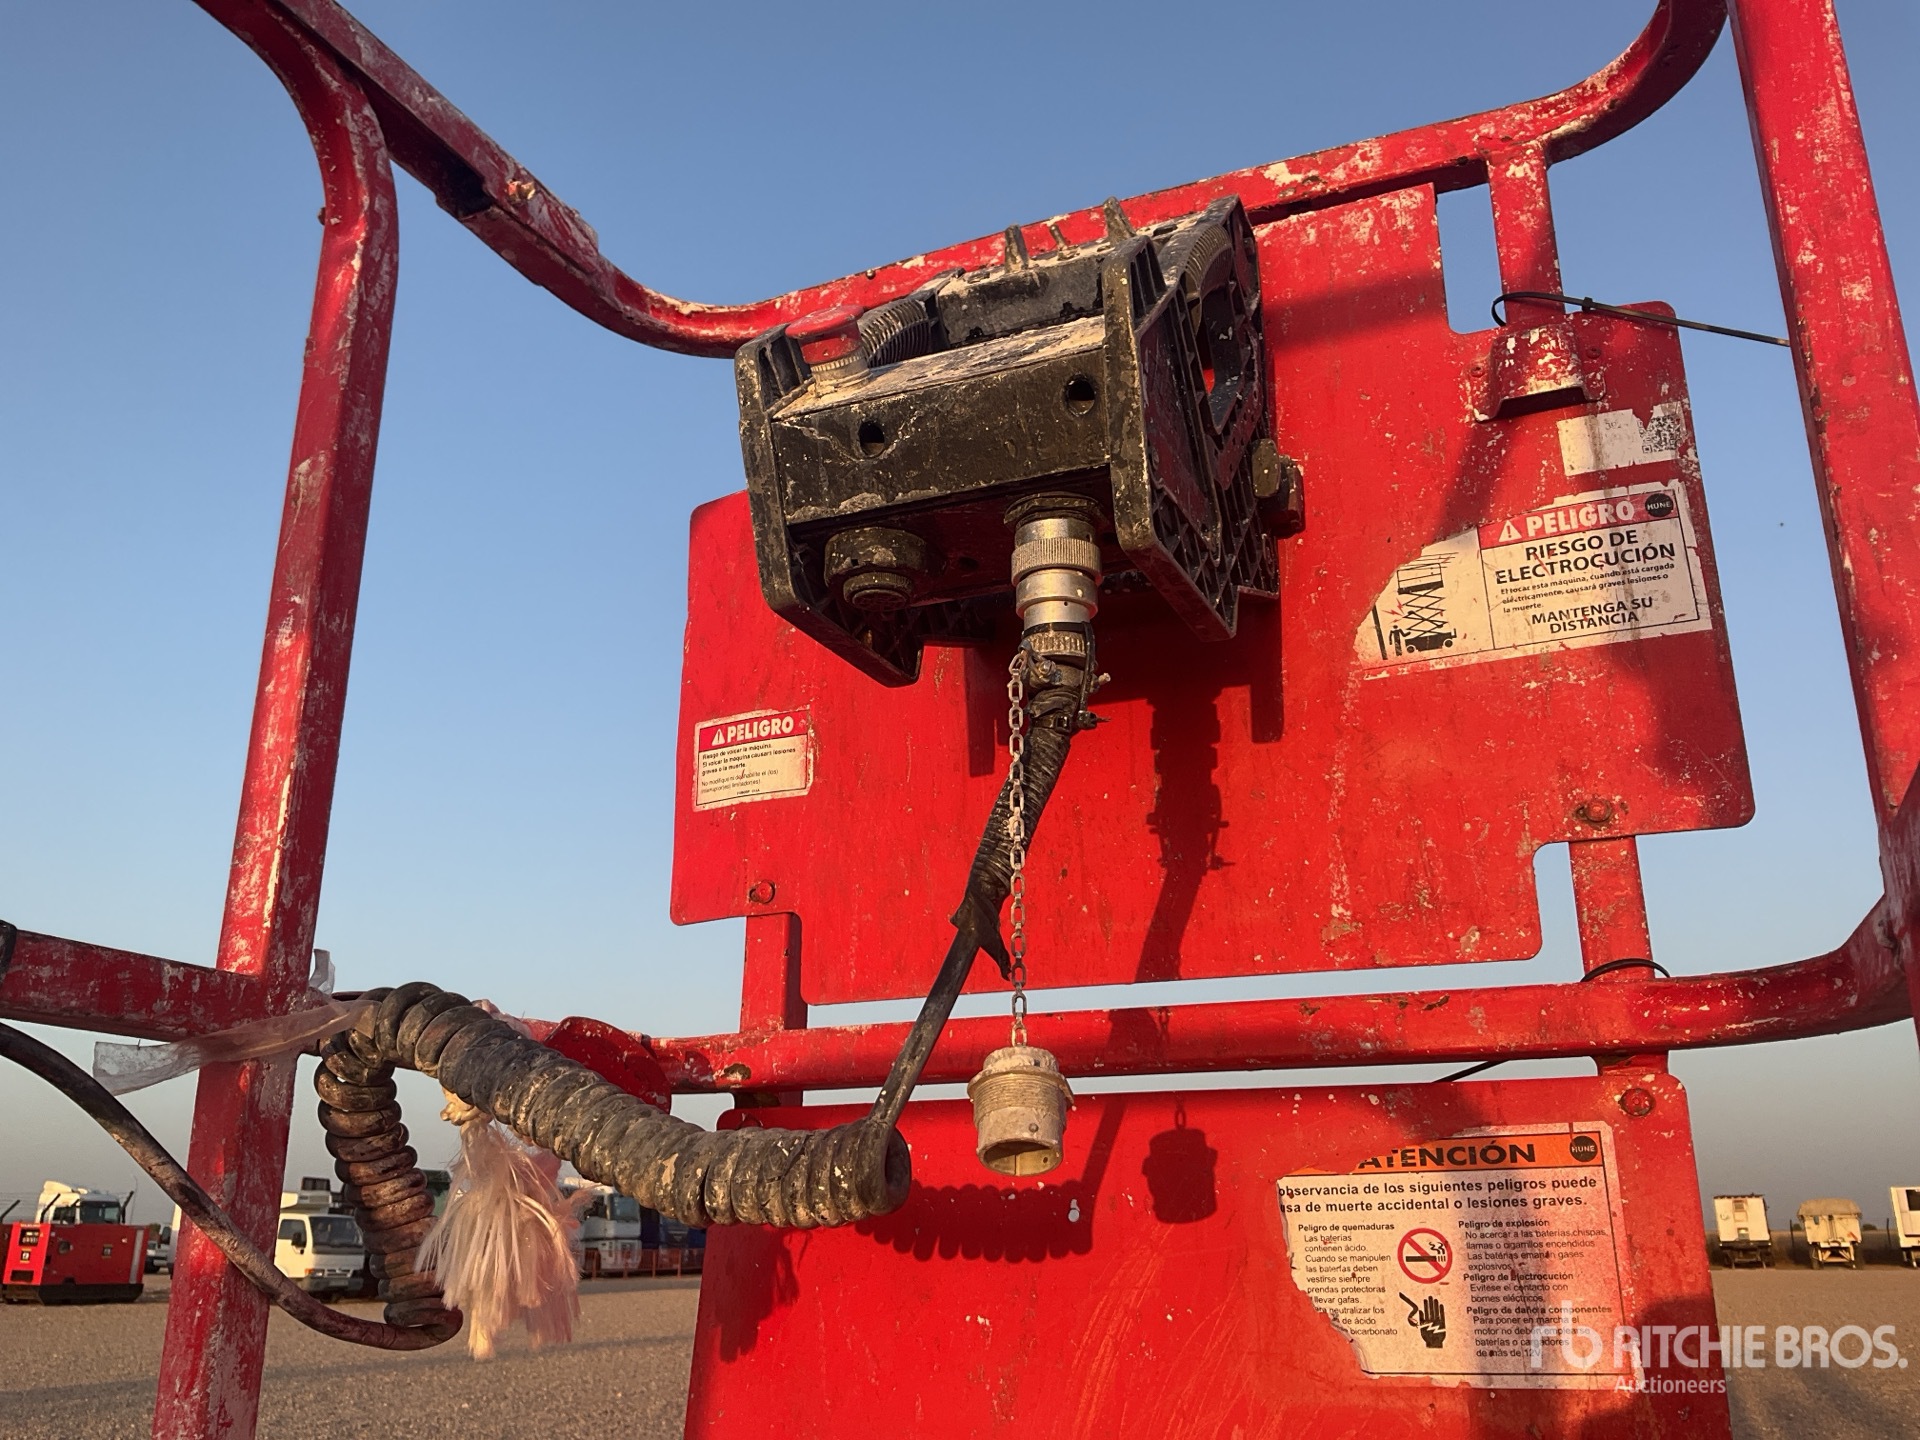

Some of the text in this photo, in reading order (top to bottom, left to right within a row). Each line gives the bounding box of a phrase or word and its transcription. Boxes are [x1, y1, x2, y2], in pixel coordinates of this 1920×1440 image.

[1526, 500, 1635, 537] PELIGRO
[1525, 529, 1639, 561] RIESGO DE
[1495, 543, 1676, 585] ELECTROCUCIÓN
[1590, 570, 1621, 580] cuando
[1622, 566, 1640, 575] está
[1641, 562, 1675, 572] cargada
[1565, 583, 1597, 594] causará
[1598, 580, 1626, 590] graves
[1627, 575, 1662, 585] lesiones
[1531, 596, 1653, 625] MANTENGA SU
[1549, 611, 1640, 634] DISTANCIA
[727, 716, 794, 743] PELIGRO
[1279, 1184, 1359, 1197] observancia
[1363, 1183, 1380, 1194] de
[1409, 1181, 1483, 1196] siguientes
[1488, 1178, 1547, 1193] peligros
[1551, 1177, 1597, 1191] puede
[1305, 1202, 1322, 1212] de
[1326, 1200, 1373, 1212] muerte
[1377, 1198, 1450, 1210] accidental
[1453, 1199, 1463, 1209] o
[1467, 1196, 1529, 1208] lesiones
[1532, 1195, 1588, 1210] graves.
[1298, 1223, 1395, 1233] Peligro de quemaduras
[1458, 1219, 1550, 1230] Peligro de explosión
[1465, 1231, 1478, 1239] No
[1479, 1231, 1511, 1239] acercar
[1520, 1230, 1534, 1238] las
[1304, 1244, 1343, 1252] contienen
[1466, 1242, 1494, 1250] llamas
[1305, 1254, 1336, 1262] Cuando
[1350, 1254, 1391, 1263] manipulen
[1467, 1252, 1483, 1260] Las
[1557, 1251, 1585, 1260] gases
[1306, 1265, 1318, 1273] las
[1353, 1264, 1378, 1272] deben
[1306, 1275, 1370, 1284] vestirse siempre
[1463, 1273, 1496, 1283] Peligro
[1497, 1273, 1509, 1281] de
[1307, 1285, 1386, 1294] prendas protectoras
[1314, 1296, 1335, 1304] llevar
[1329, 1306, 1371, 1314] neutralizar
[1372, 1306, 1385, 1314] los
[1466, 1306, 1499, 1316] Peligro
[1500, 1306, 1512, 1314] de
[1548, 1306, 1612, 1315] componentes
[1342, 1317, 1352, 1325] de
[1472, 1316, 1494, 1324] Para
[1496, 1317, 1520, 1326] poner
[1536, 1316, 1570, 1324] marcha
[1571, 1316, 1580, 1324] el
[1350, 1327, 1397, 1335] bicarbonato
[1474, 1327, 1499, 1335] motor
[1476, 1349, 1488, 1357] de
[1509, 1349, 1522, 1357] de
